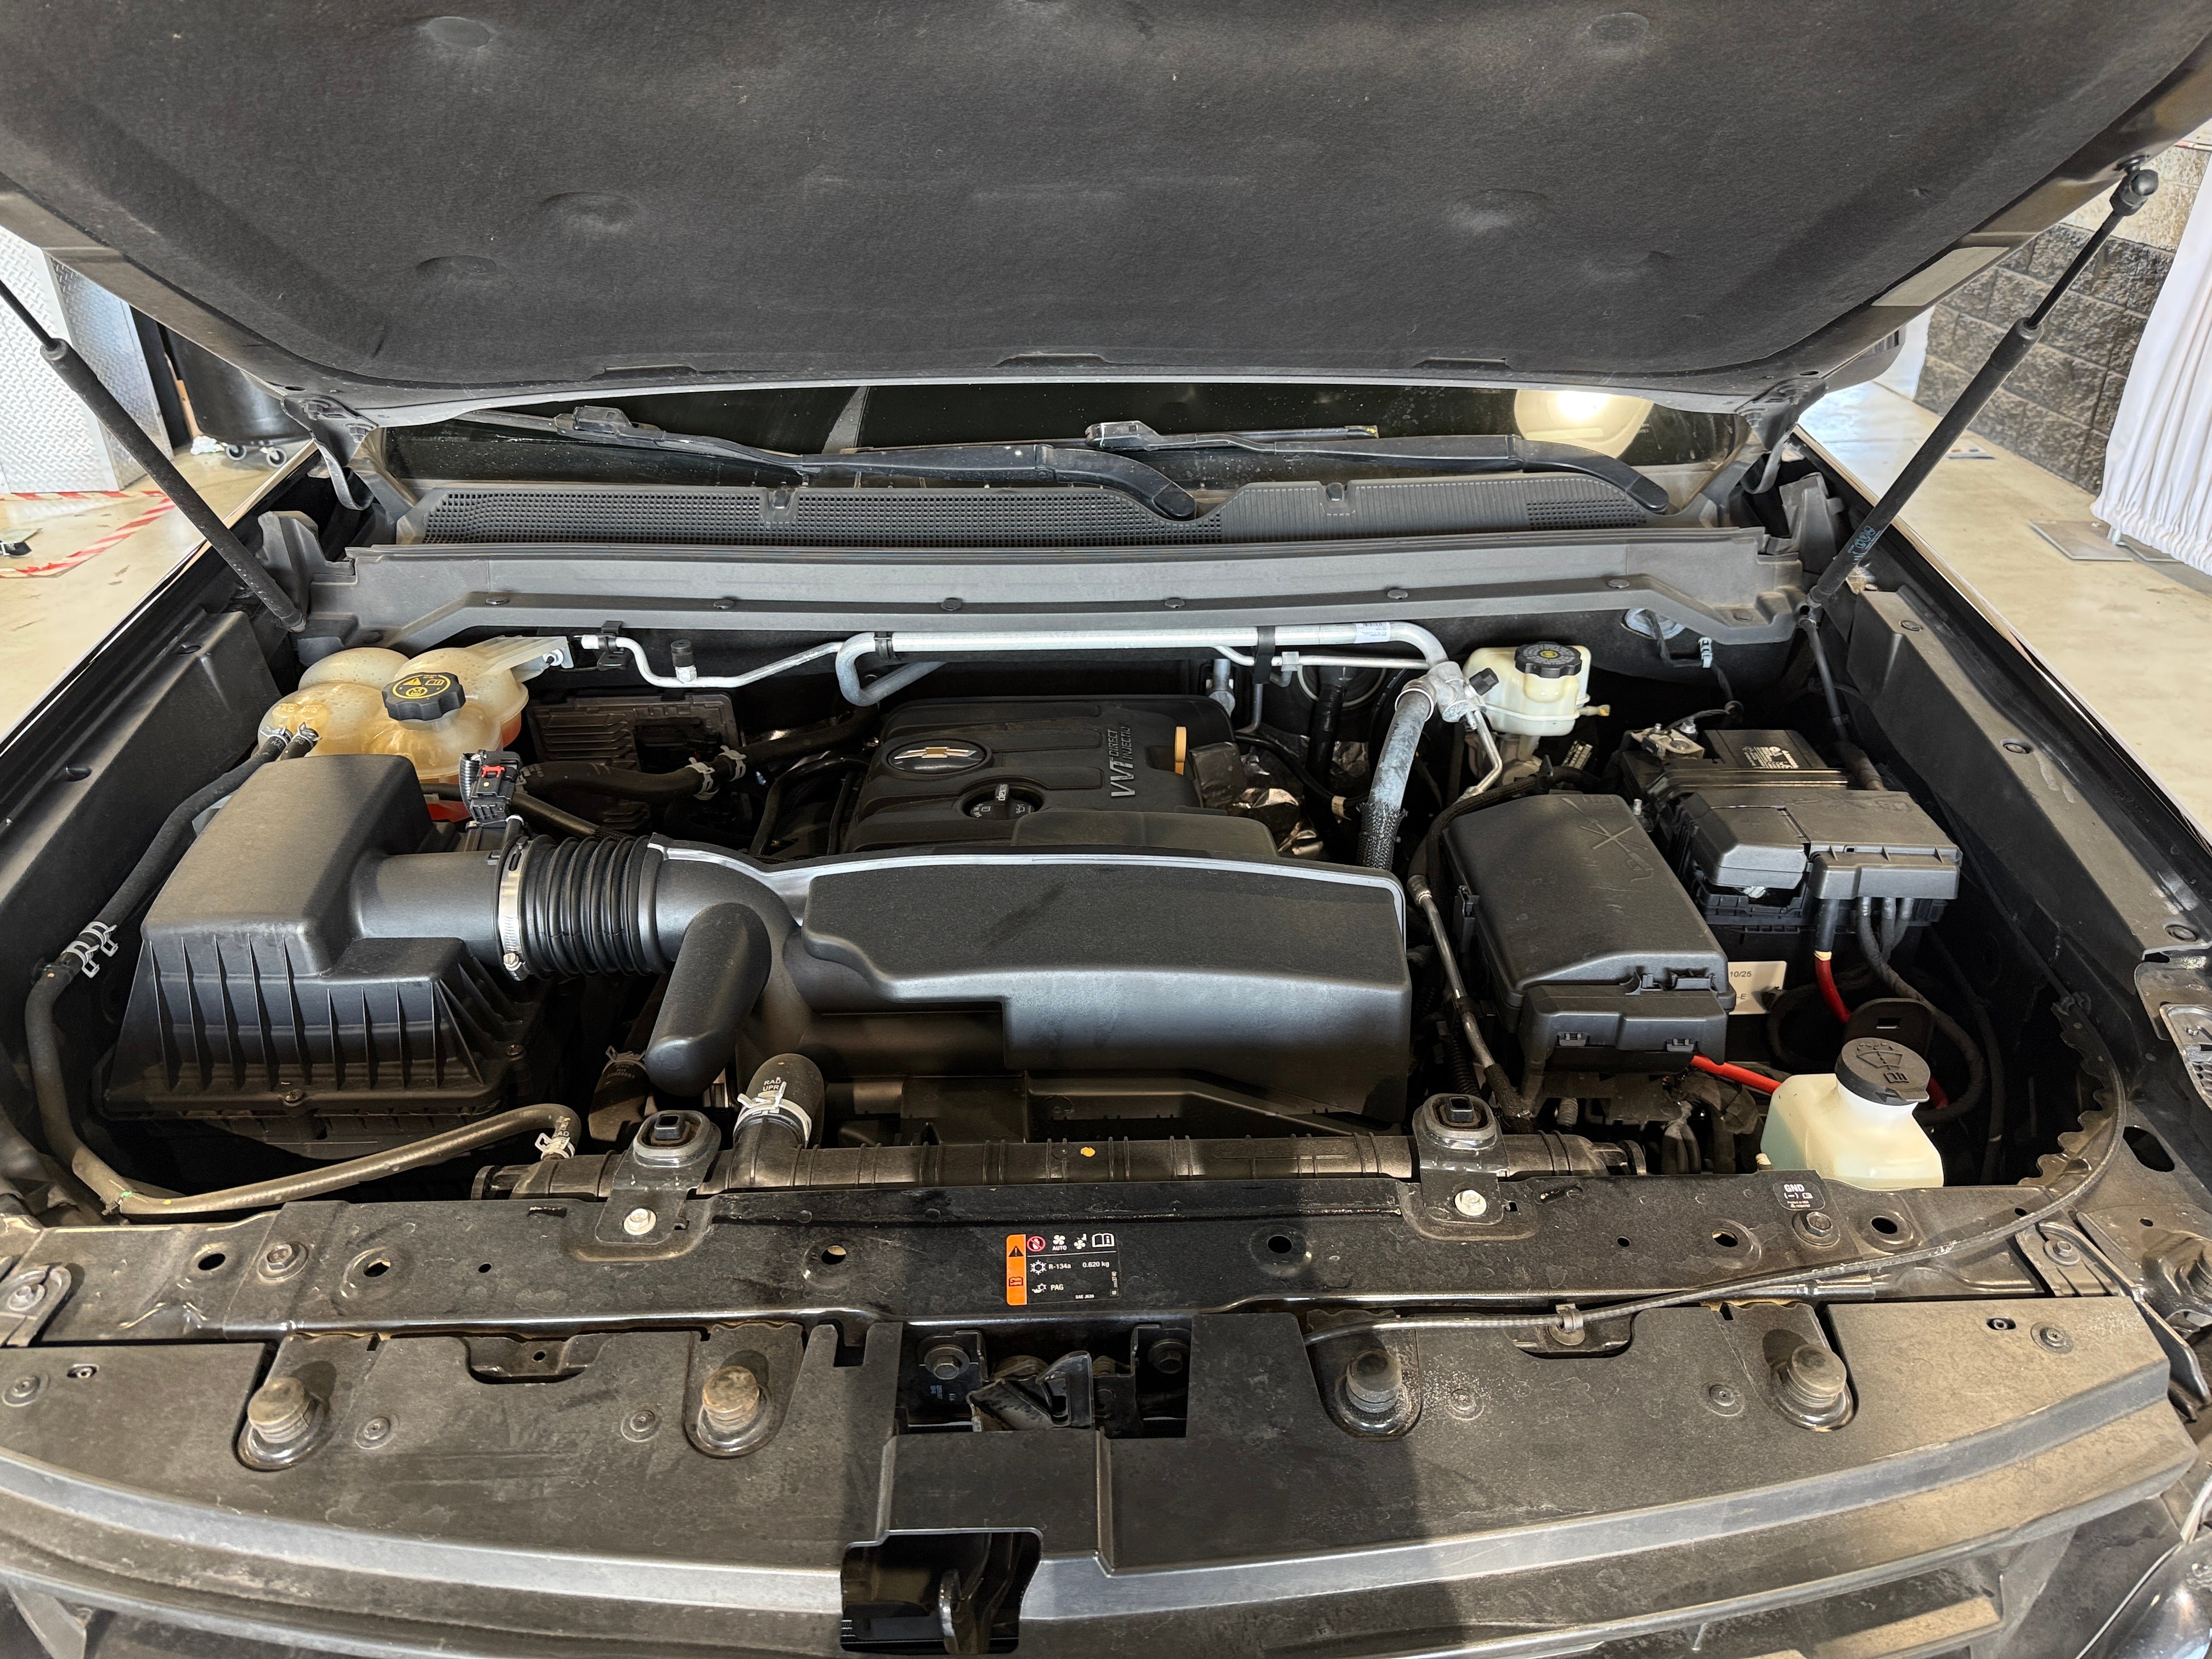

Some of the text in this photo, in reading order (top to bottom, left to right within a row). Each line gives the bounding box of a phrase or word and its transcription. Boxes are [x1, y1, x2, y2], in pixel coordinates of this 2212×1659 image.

[1108, 729, 1119, 757] DIRECT
[1109, 757, 1136, 797] VVT
[1784, 1184, 1805, 1193] GND
